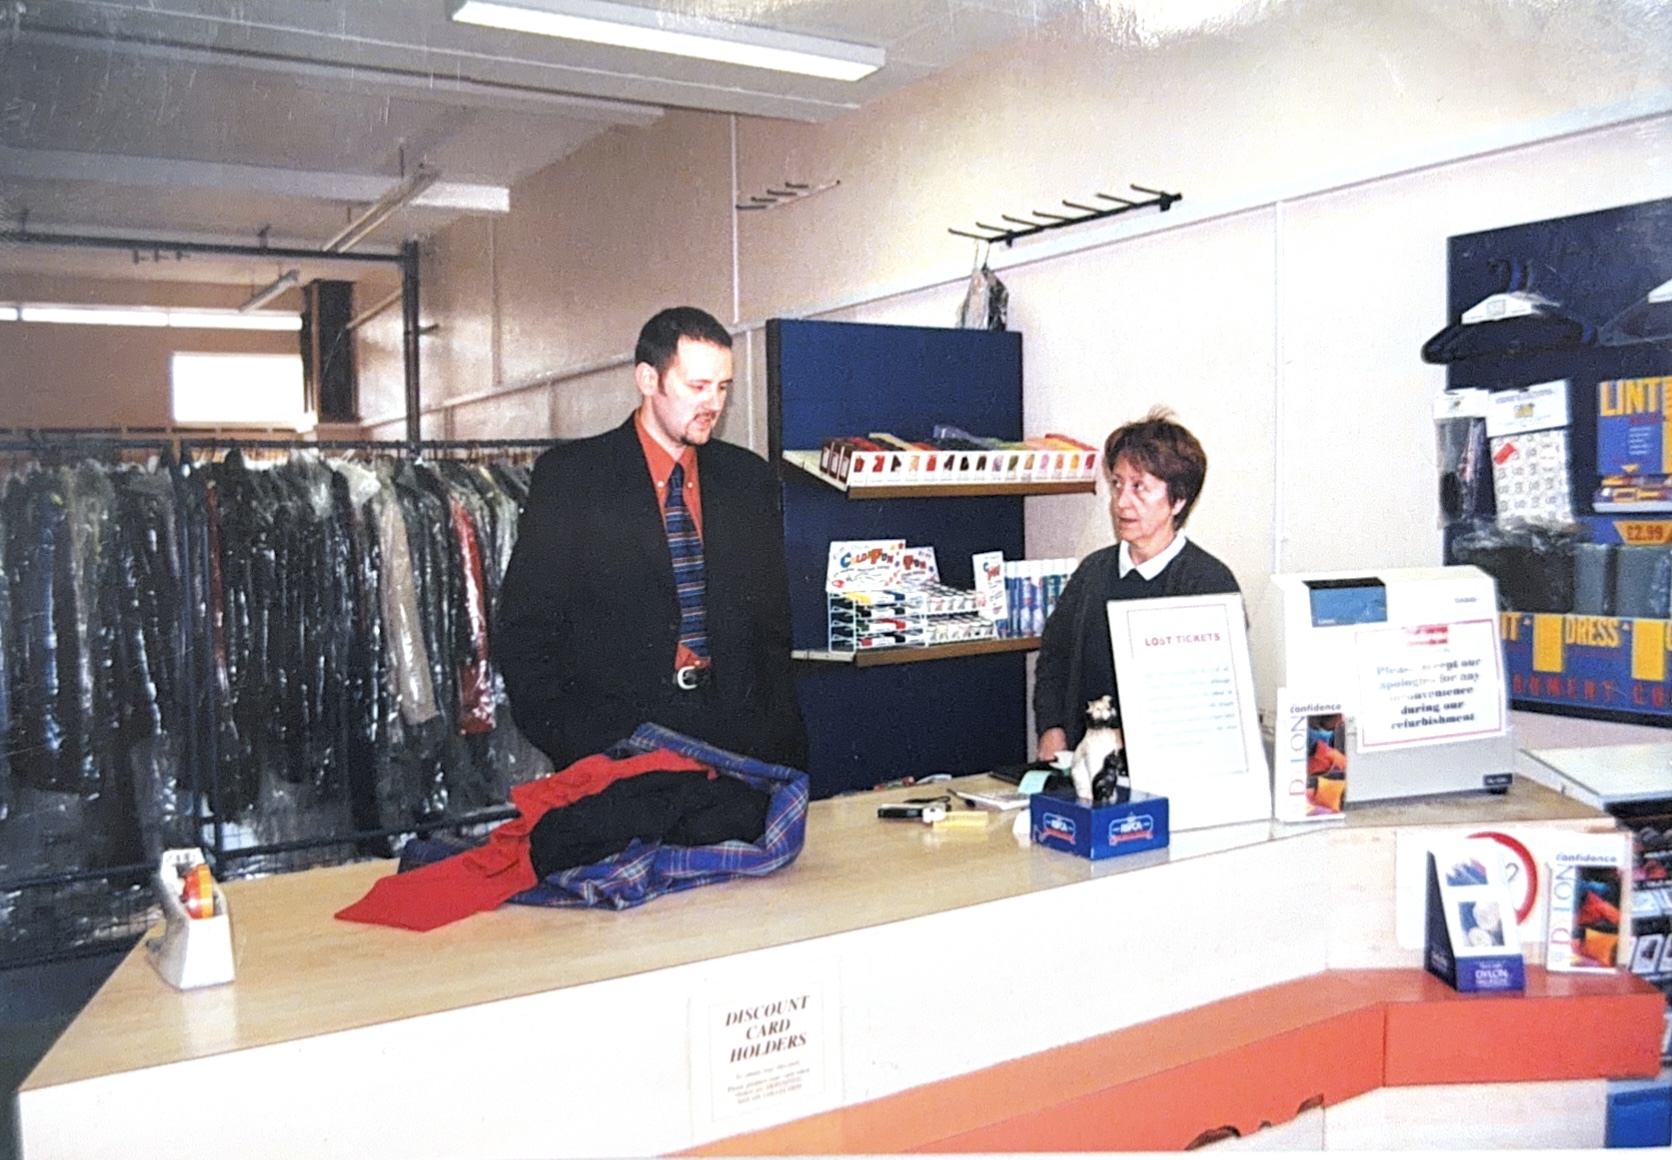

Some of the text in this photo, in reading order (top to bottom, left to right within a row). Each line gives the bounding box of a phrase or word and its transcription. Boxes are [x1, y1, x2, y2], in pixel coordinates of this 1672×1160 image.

[1600, 377, 1661, 416] LINT
[1627, 525, 1663, 541] £2.99
[1565, 614, 1620, 648] DRESS
[1145, 633, 1220, 646] LOST TICKETS
[1461, 658, 1481, 667] our
[1440, 673, 1457, 682] for
[1460, 672, 1479, 683] any
[1401, 701, 1465, 715] during our
[1391, 713, 1475, 729] refurbishment
[726, 995, 810, 1027] DISCOUNT
[746, 1018, 791, 1040] CARD
[730, 1032, 807, 1063] HOLDERS
